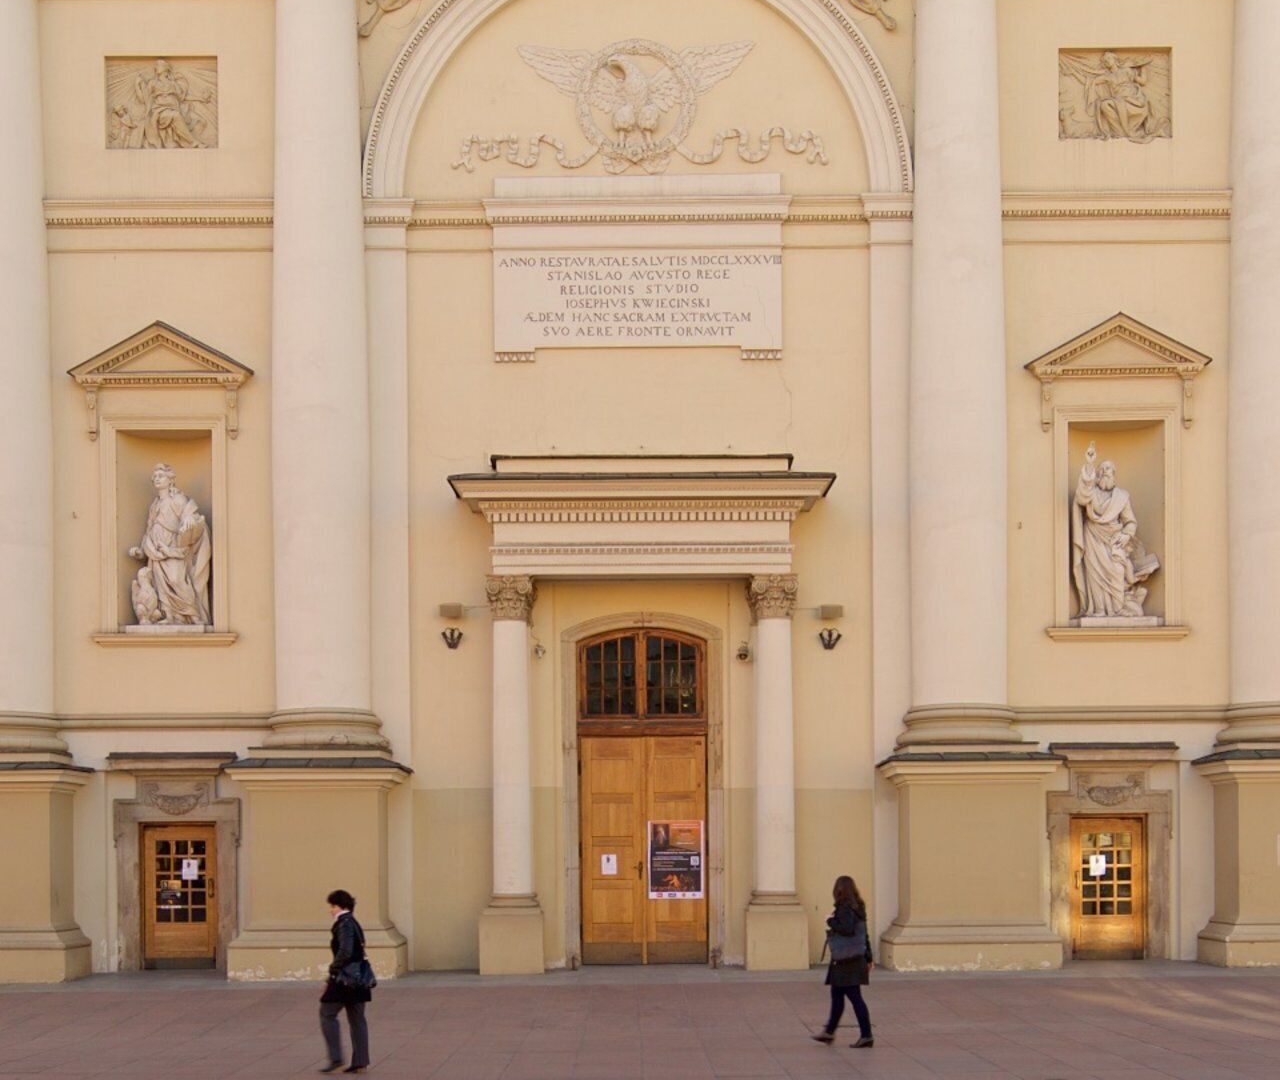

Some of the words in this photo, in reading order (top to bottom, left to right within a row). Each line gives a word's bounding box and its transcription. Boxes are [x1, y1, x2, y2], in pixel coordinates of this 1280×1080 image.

[499, 257, 536, 268] ANNO
[540, 256, 630, 268] RESTAVRATAE
[631, 255, 688, 267] SALVTIS
[547, 271, 623, 281] STANISLAO
[629, 270, 691, 281] AVGVSTO
[696, 269, 730, 280] REGE
[560, 285, 635, 296] RELIGIONIS
[645, 283, 700, 295] STVDIO
[566, 299, 626, 309] IOSEPHVS
[633, 298, 711, 309] KWIECINSKI
[572, 313, 610, 322] HANC
[613, 312, 665, 322] SACRAM
[671, 312, 752, 323] EXTRVCTAM
[543, 326, 570, 337] SVO
[576, 326, 612, 337] AERE
[618, 326, 671, 337] FRONTE
[676, 326, 735, 337] ORNAVIT
